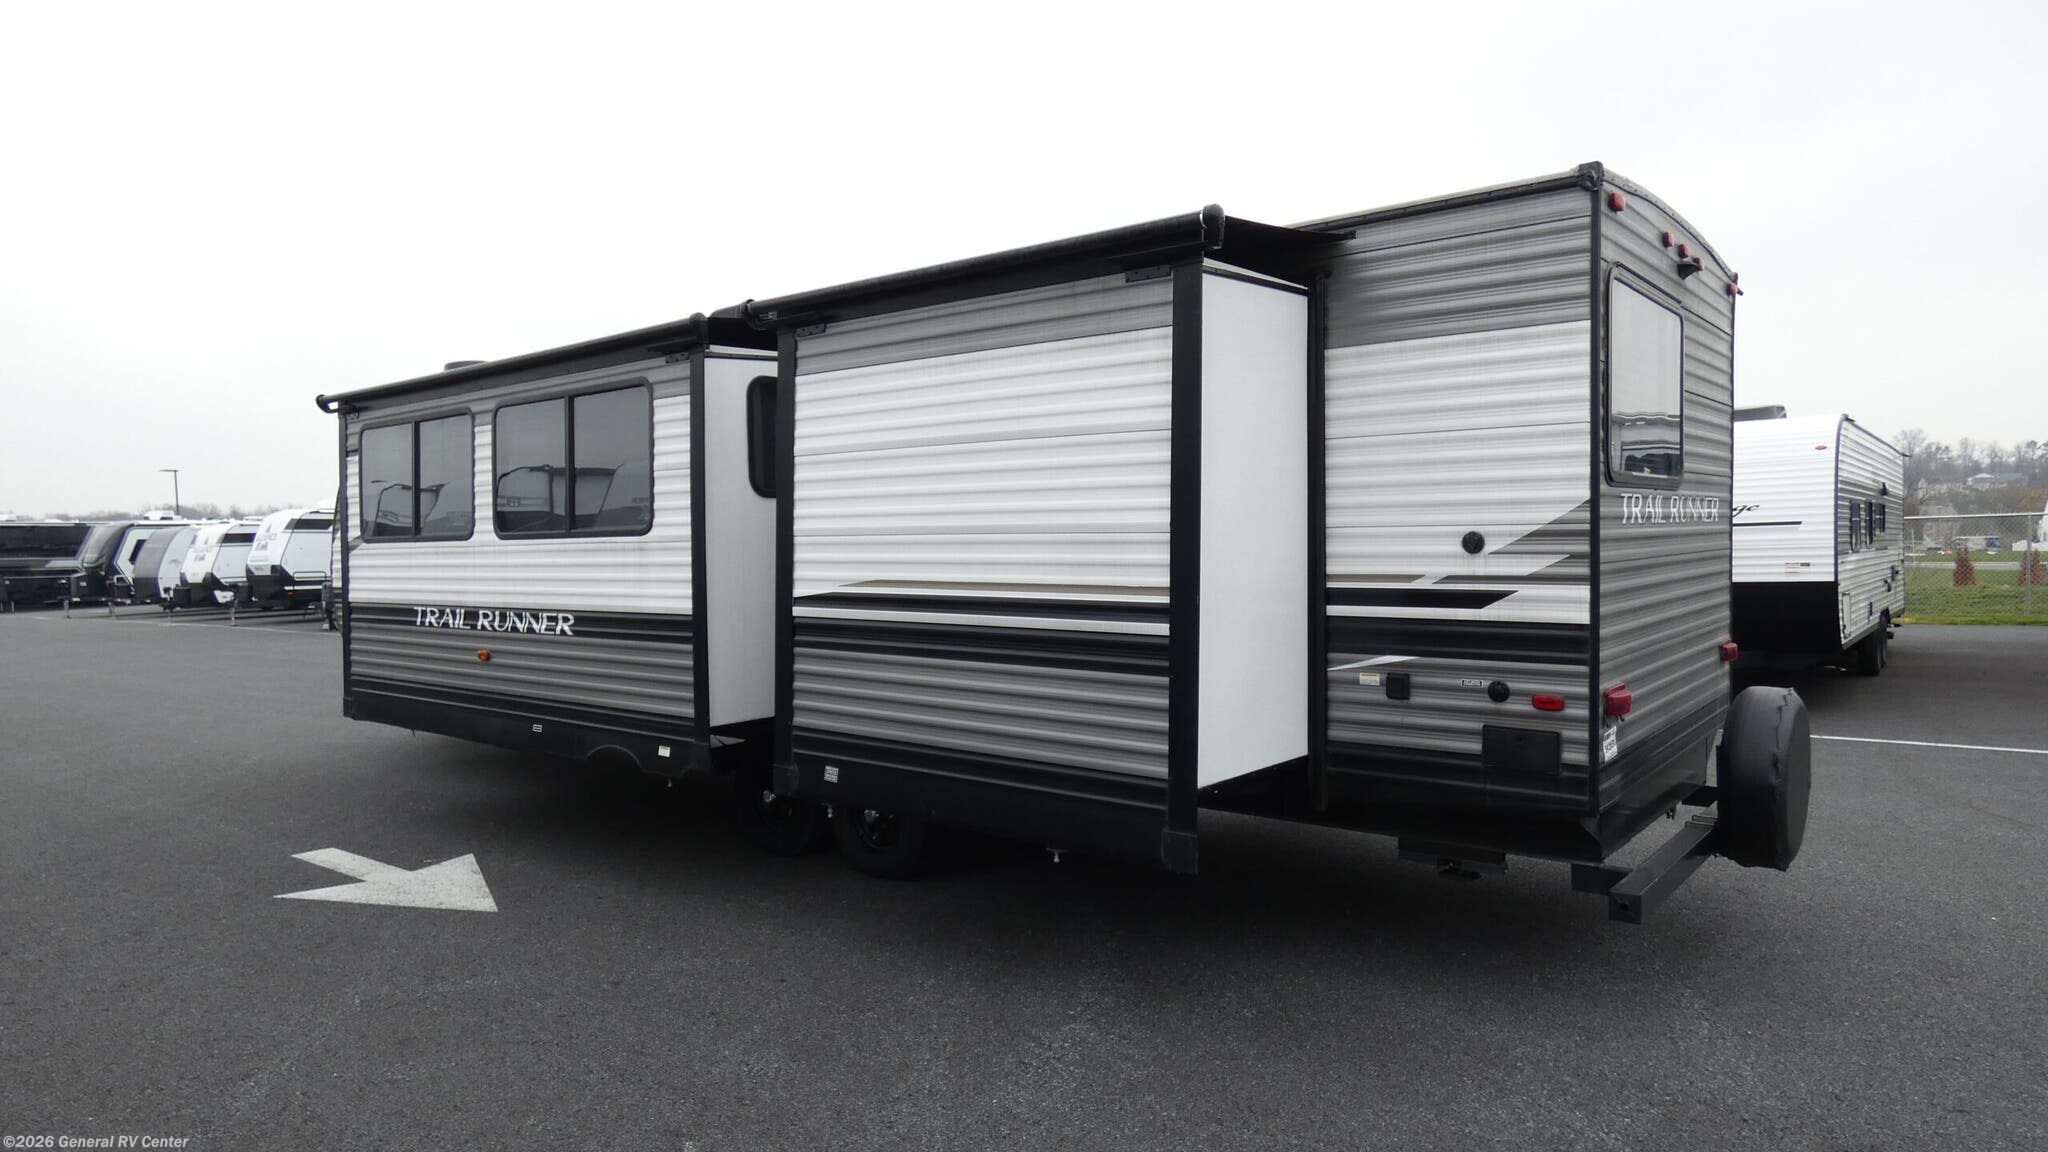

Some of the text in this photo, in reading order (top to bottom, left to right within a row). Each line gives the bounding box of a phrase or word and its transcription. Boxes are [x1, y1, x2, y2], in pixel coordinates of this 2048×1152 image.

[1621, 493, 1719, 524] TRAIL RUNNER
[413, 606, 575, 636] TRAIL RUNNER
